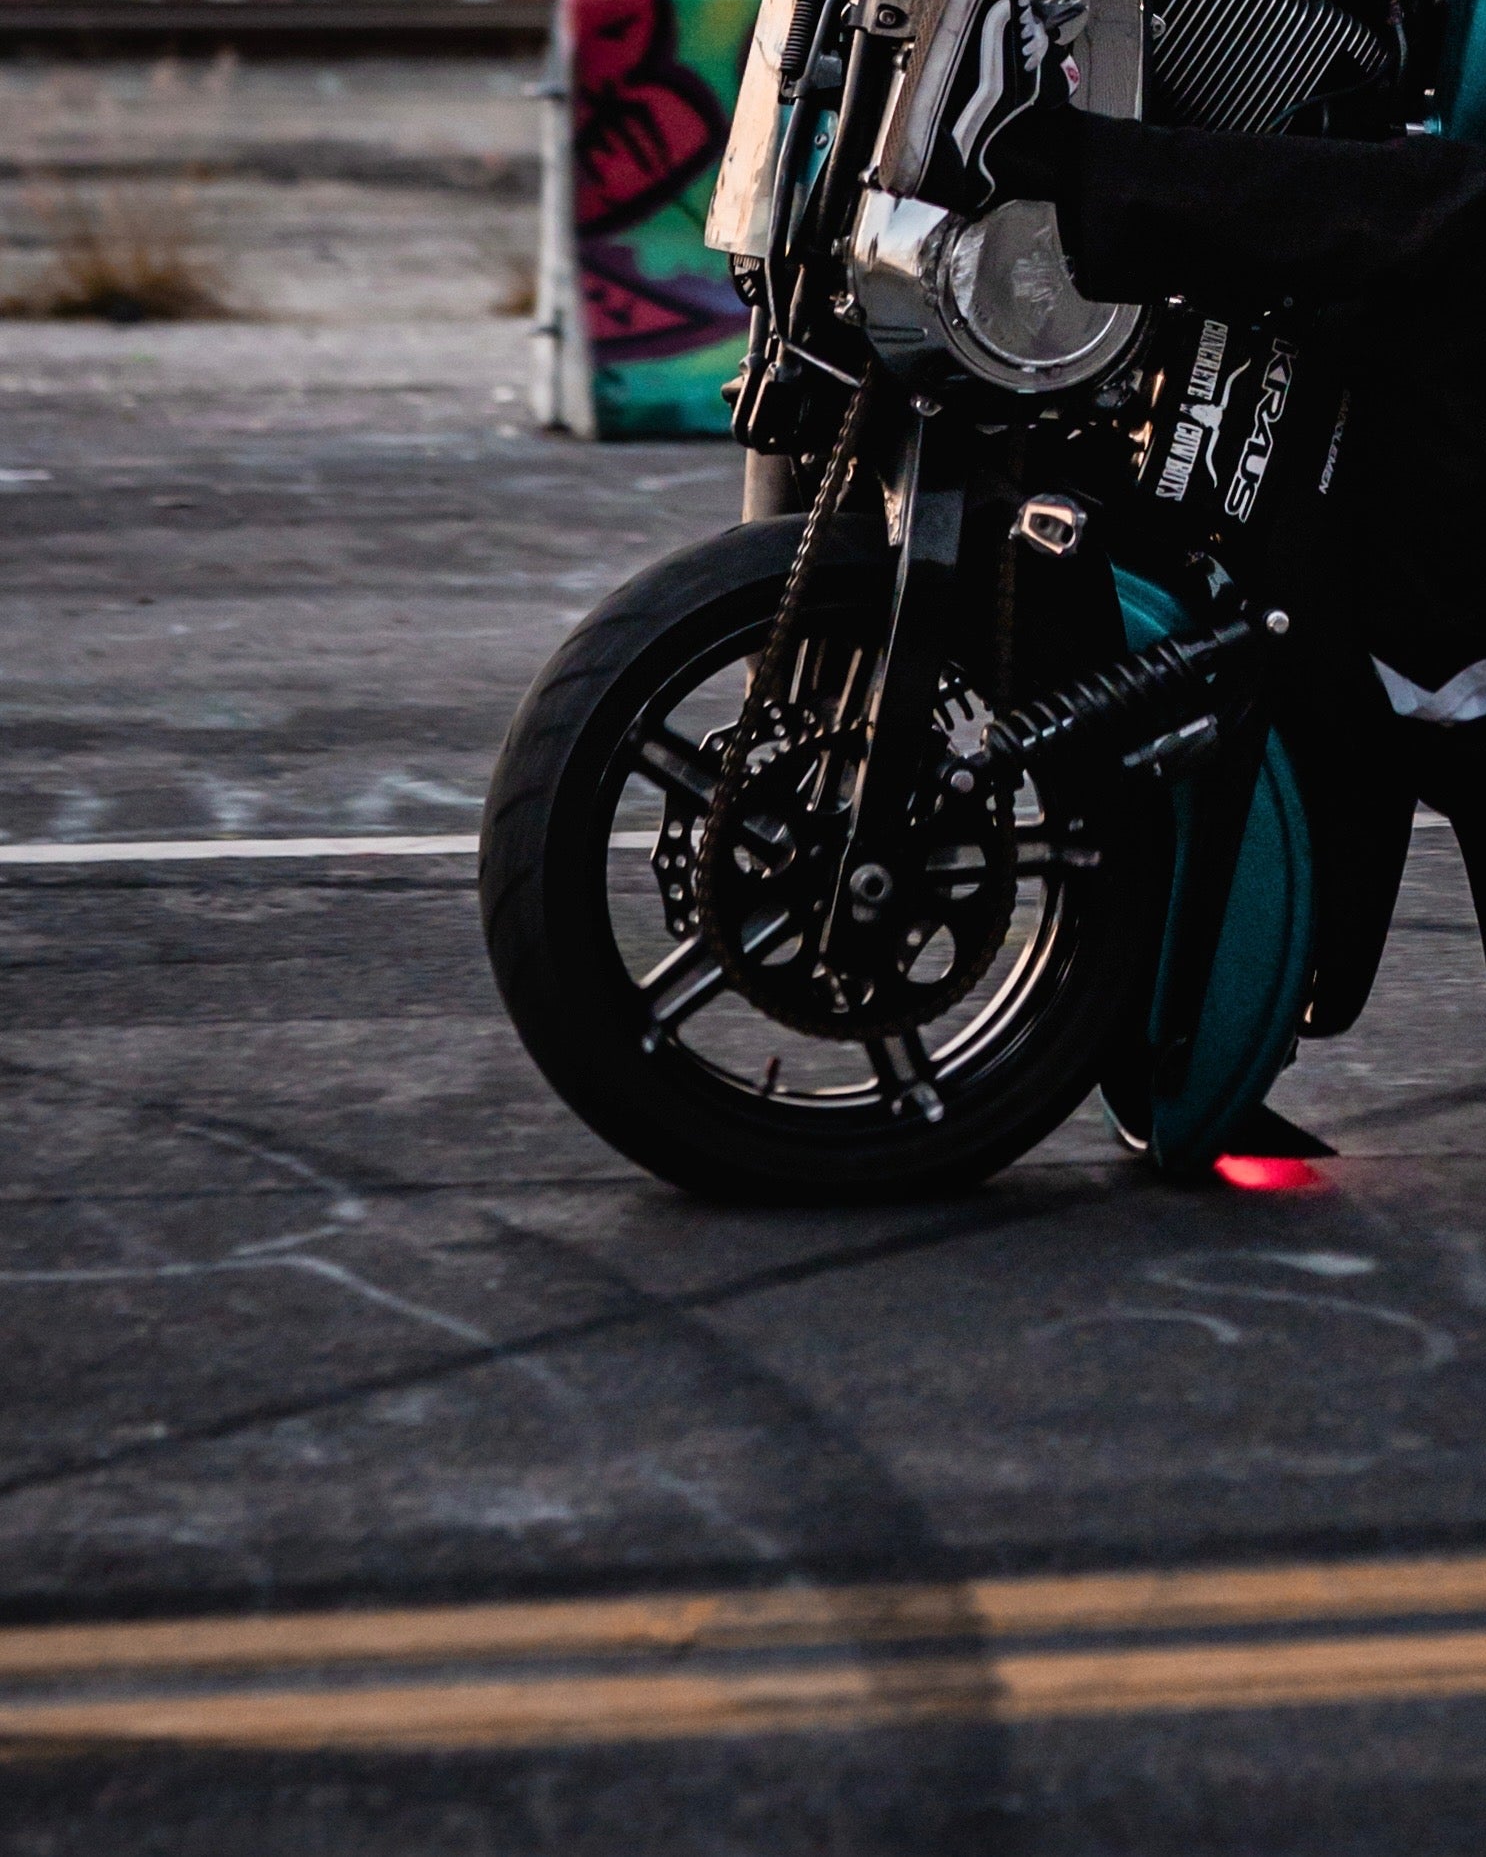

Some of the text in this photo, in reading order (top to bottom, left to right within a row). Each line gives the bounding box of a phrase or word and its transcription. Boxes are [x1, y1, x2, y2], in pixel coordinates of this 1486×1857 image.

[1155, 319, 1229, 502] CONCRETE COWBOYS
[1224, 337, 1299, 523] KRAUS
